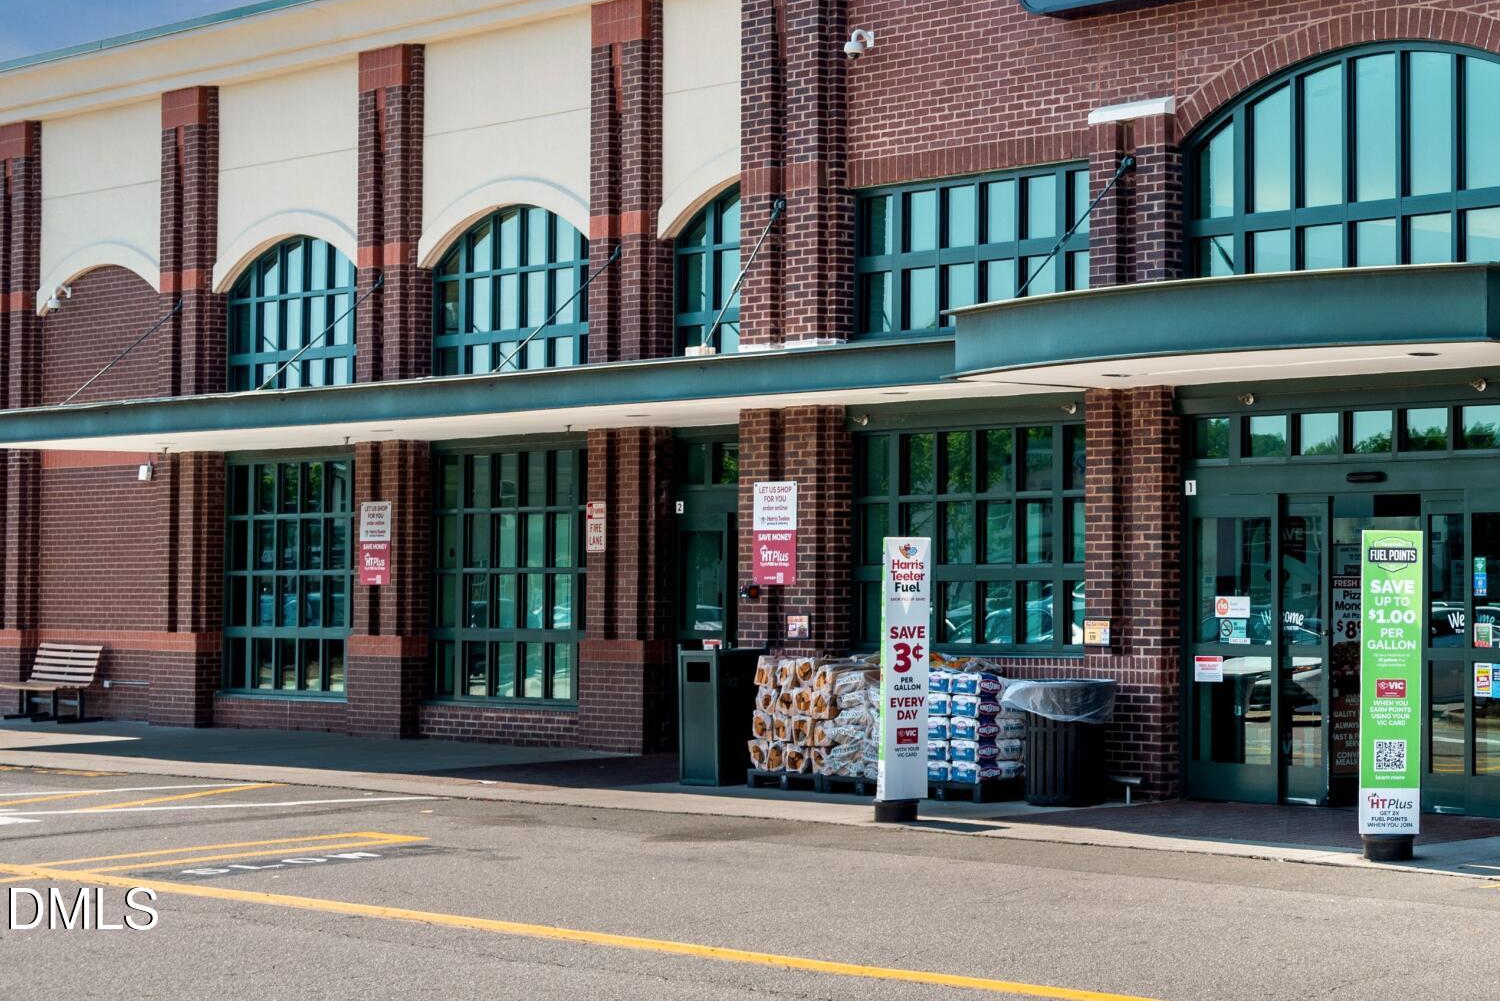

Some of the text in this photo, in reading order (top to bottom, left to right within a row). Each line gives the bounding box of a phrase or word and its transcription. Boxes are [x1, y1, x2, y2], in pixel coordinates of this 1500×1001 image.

[1188, 482, 1194, 493] 1
[590, 523, 602, 532] FIRE
[590, 536, 603, 545] LANE
[772, 533, 792, 541] MONEY
[1370, 550, 1387, 560] FUEL
[1389, 550, 1416, 560] POINTS
[892, 560, 924, 569] Harris
[891, 571, 925, 580] Teeter
[895, 582, 920, 592] Fuel
[1370, 579, 1414, 594] SAVE
[1343, 590, 1361, 600] Pizz
[1335, 601, 1361, 610] Mon
[1375, 597, 1410, 606] UP TO
[1368, 609, 1416, 624] $1.00
[890, 626, 925, 639] SAVE
[1381, 628, 1403, 638] PER
[1367, 640, 1416, 650] GALLON
[893, 643, 924, 673] 3¢
[890, 697, 925, 708] EVERY
[897, 710, 918, 720] DAY
[180, 851, 382, 876] SLOW
